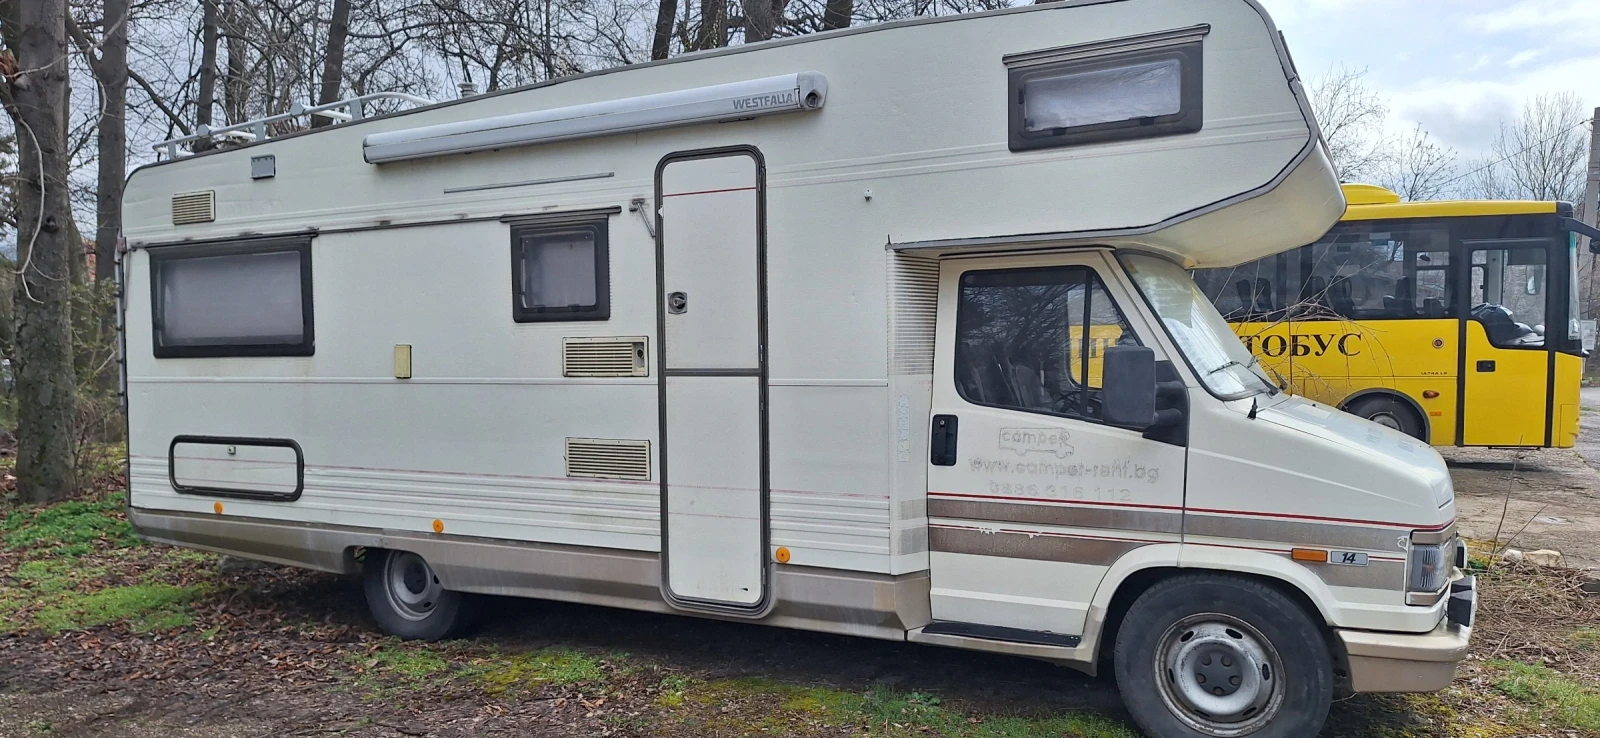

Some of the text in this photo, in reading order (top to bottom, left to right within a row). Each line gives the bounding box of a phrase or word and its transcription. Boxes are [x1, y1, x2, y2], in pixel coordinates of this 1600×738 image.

[732, 93, 793, 109] WESTFALIA
[1093, 487, 1132, 502] 112
[1342, 552, 1356, 563] 14
